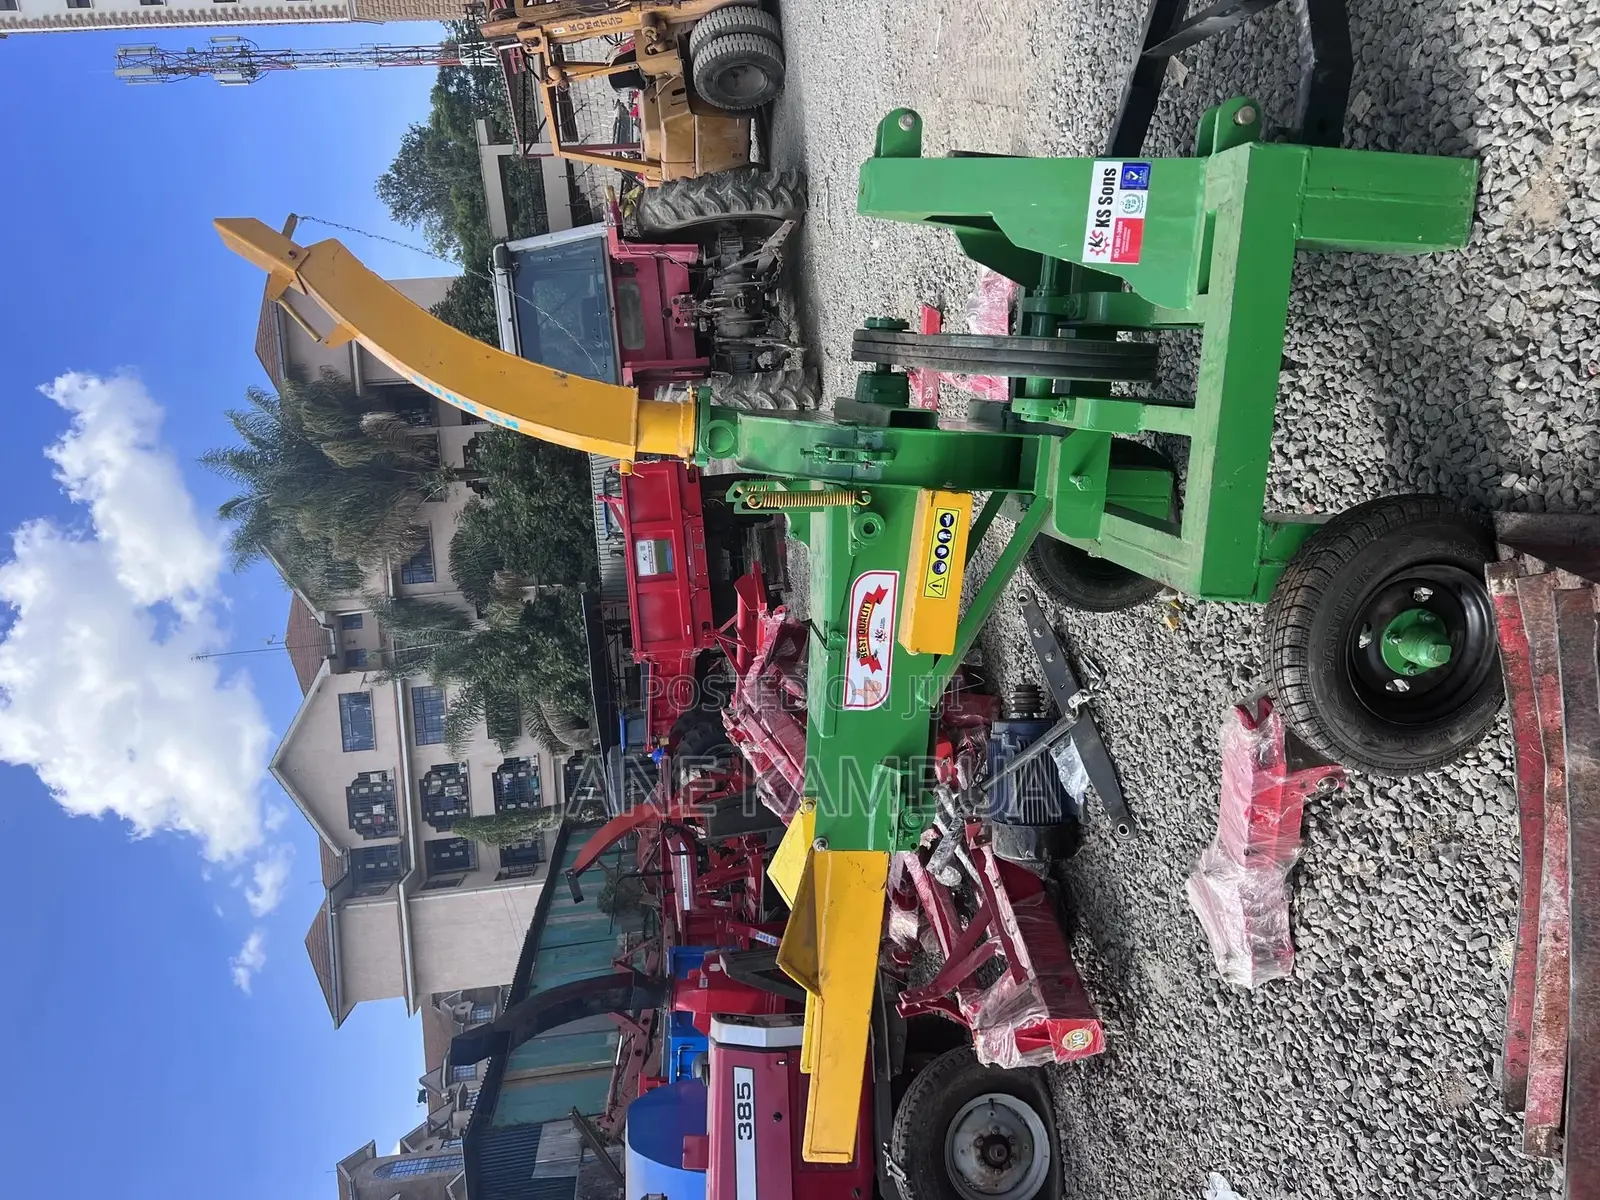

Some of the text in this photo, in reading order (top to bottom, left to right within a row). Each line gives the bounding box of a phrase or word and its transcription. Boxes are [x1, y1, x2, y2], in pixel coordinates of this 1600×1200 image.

[570, 17, 622, 32] KOMATSU
[1095, 168, 1116, 228] KS Sons
[857, 600, 872, 658] BEST QUALITY
[737, 1082, 752, 1140] 385
